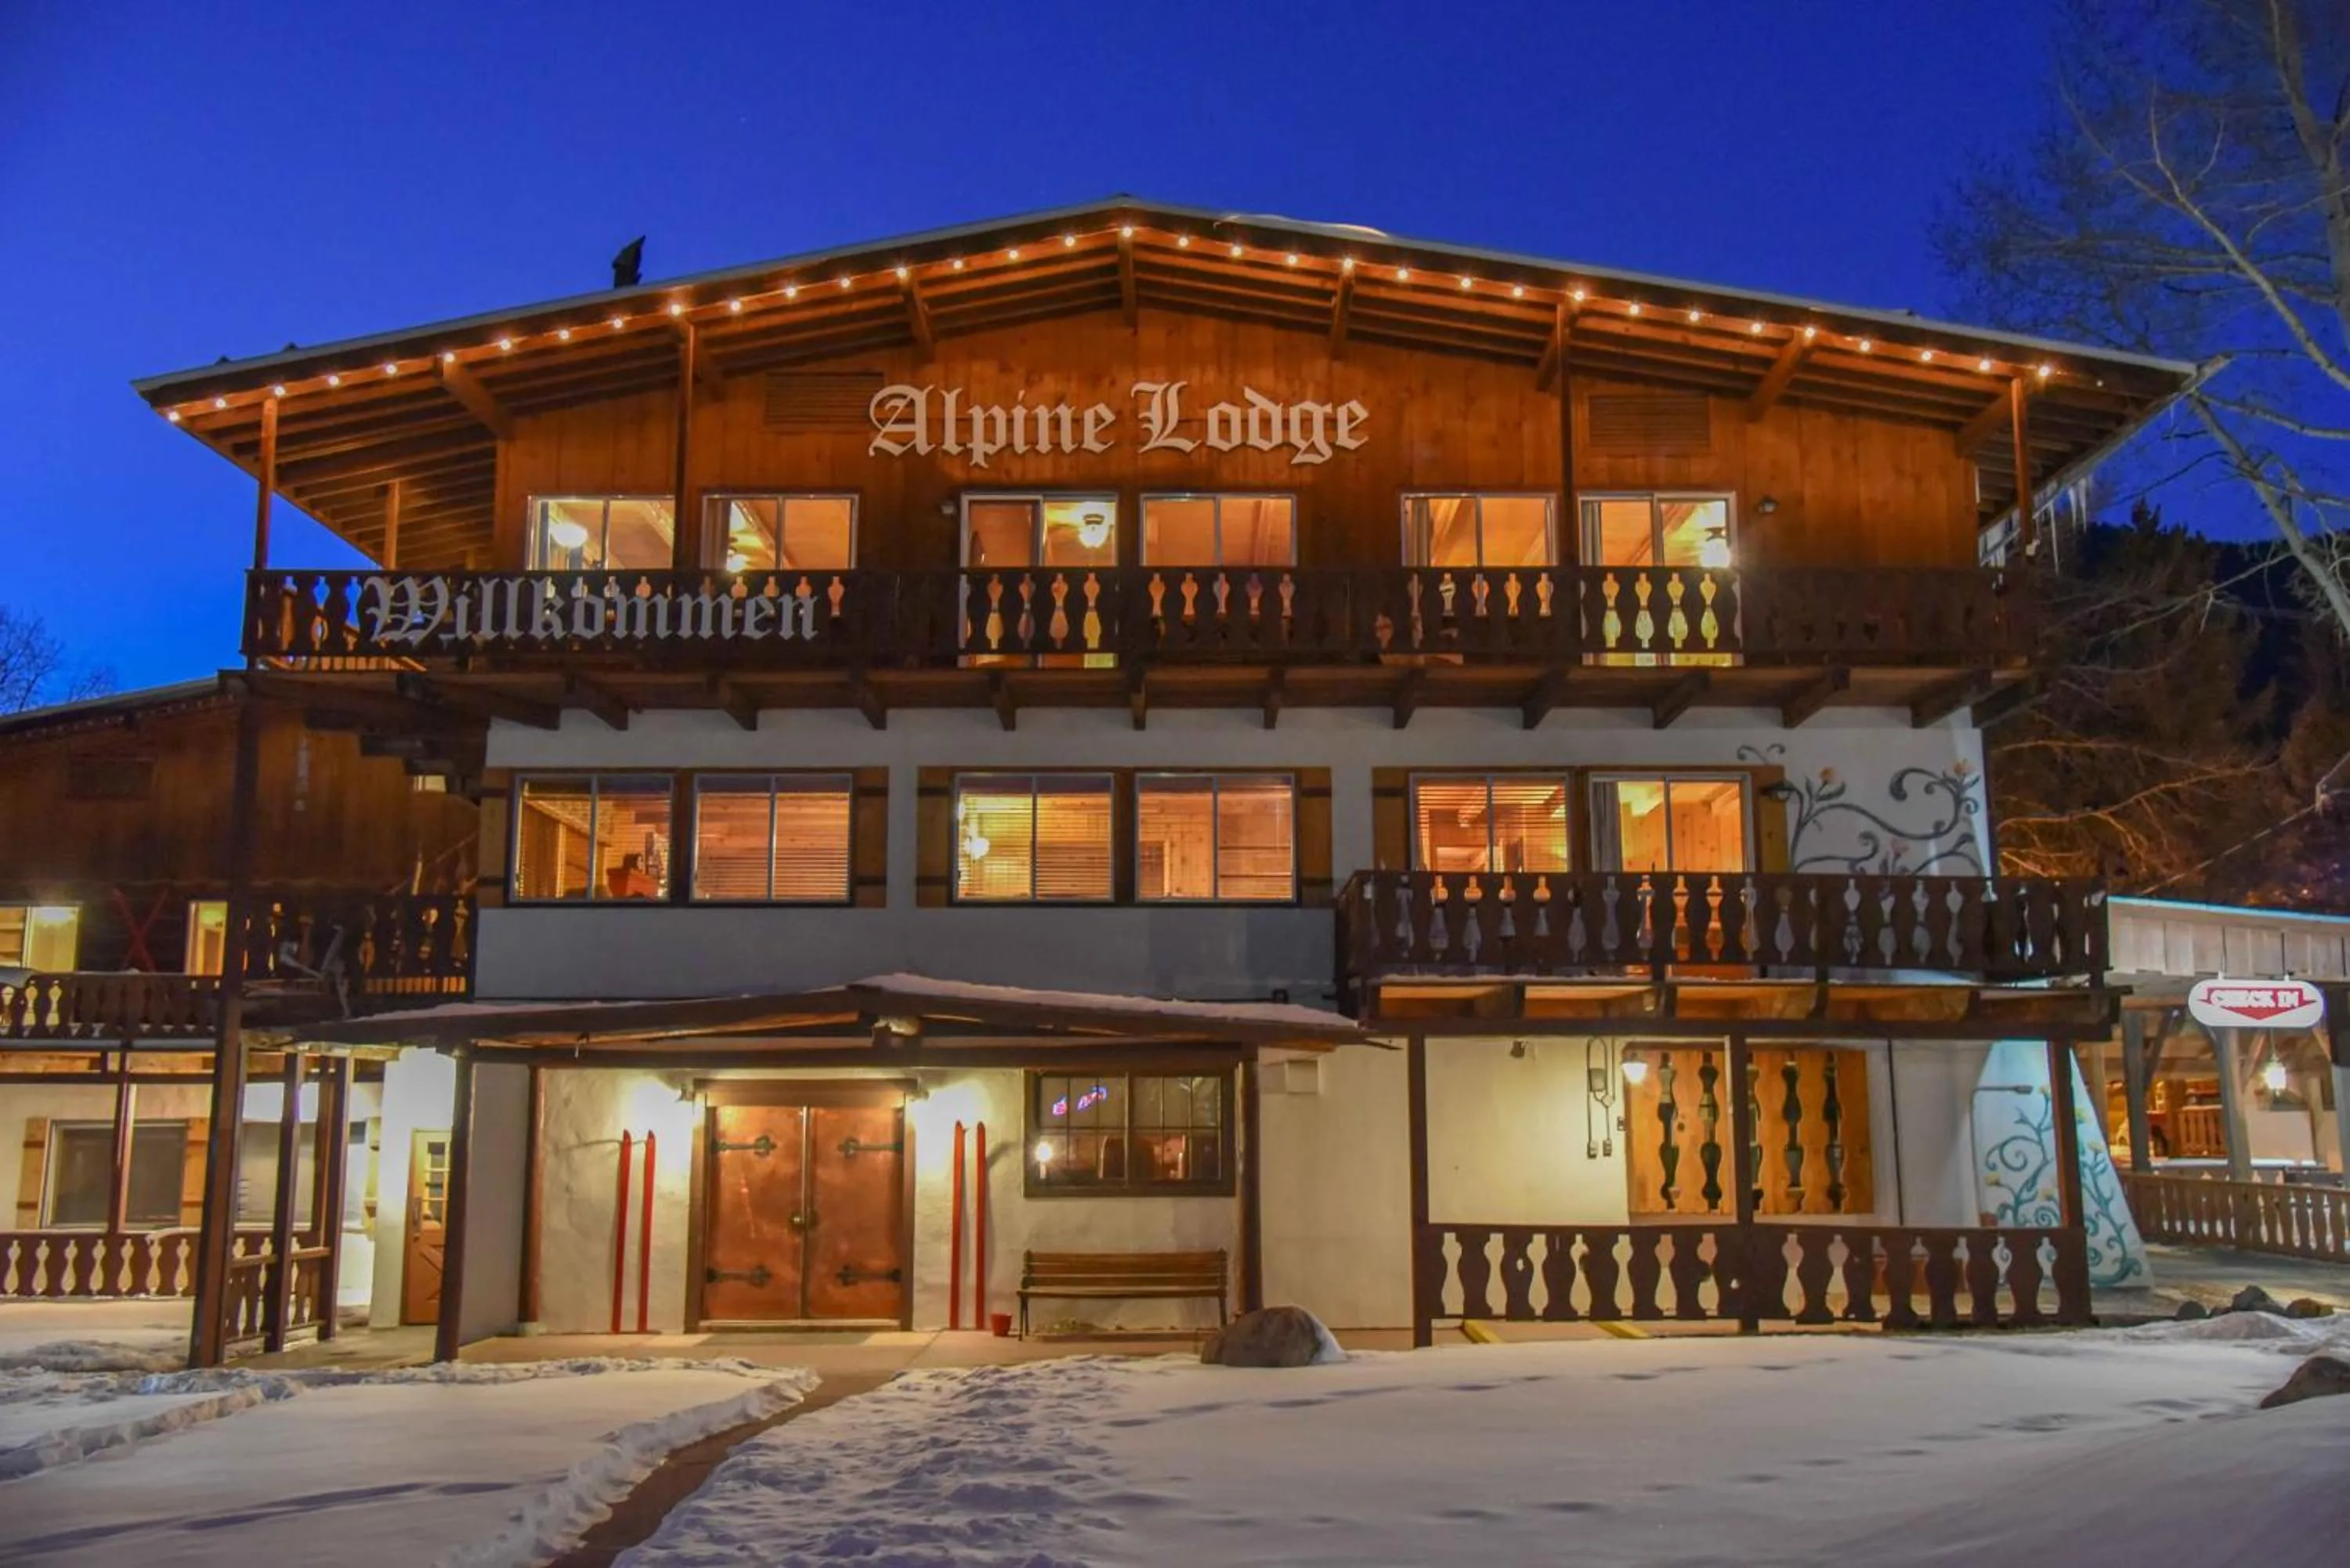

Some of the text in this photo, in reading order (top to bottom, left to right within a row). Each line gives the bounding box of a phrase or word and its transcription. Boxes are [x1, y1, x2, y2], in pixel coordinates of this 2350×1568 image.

[868, 381, 1370, 468] Alpine Lodge
[363, 576, 819, 641] Willkommen
[2210, 989, 2276, 1008] CCK
